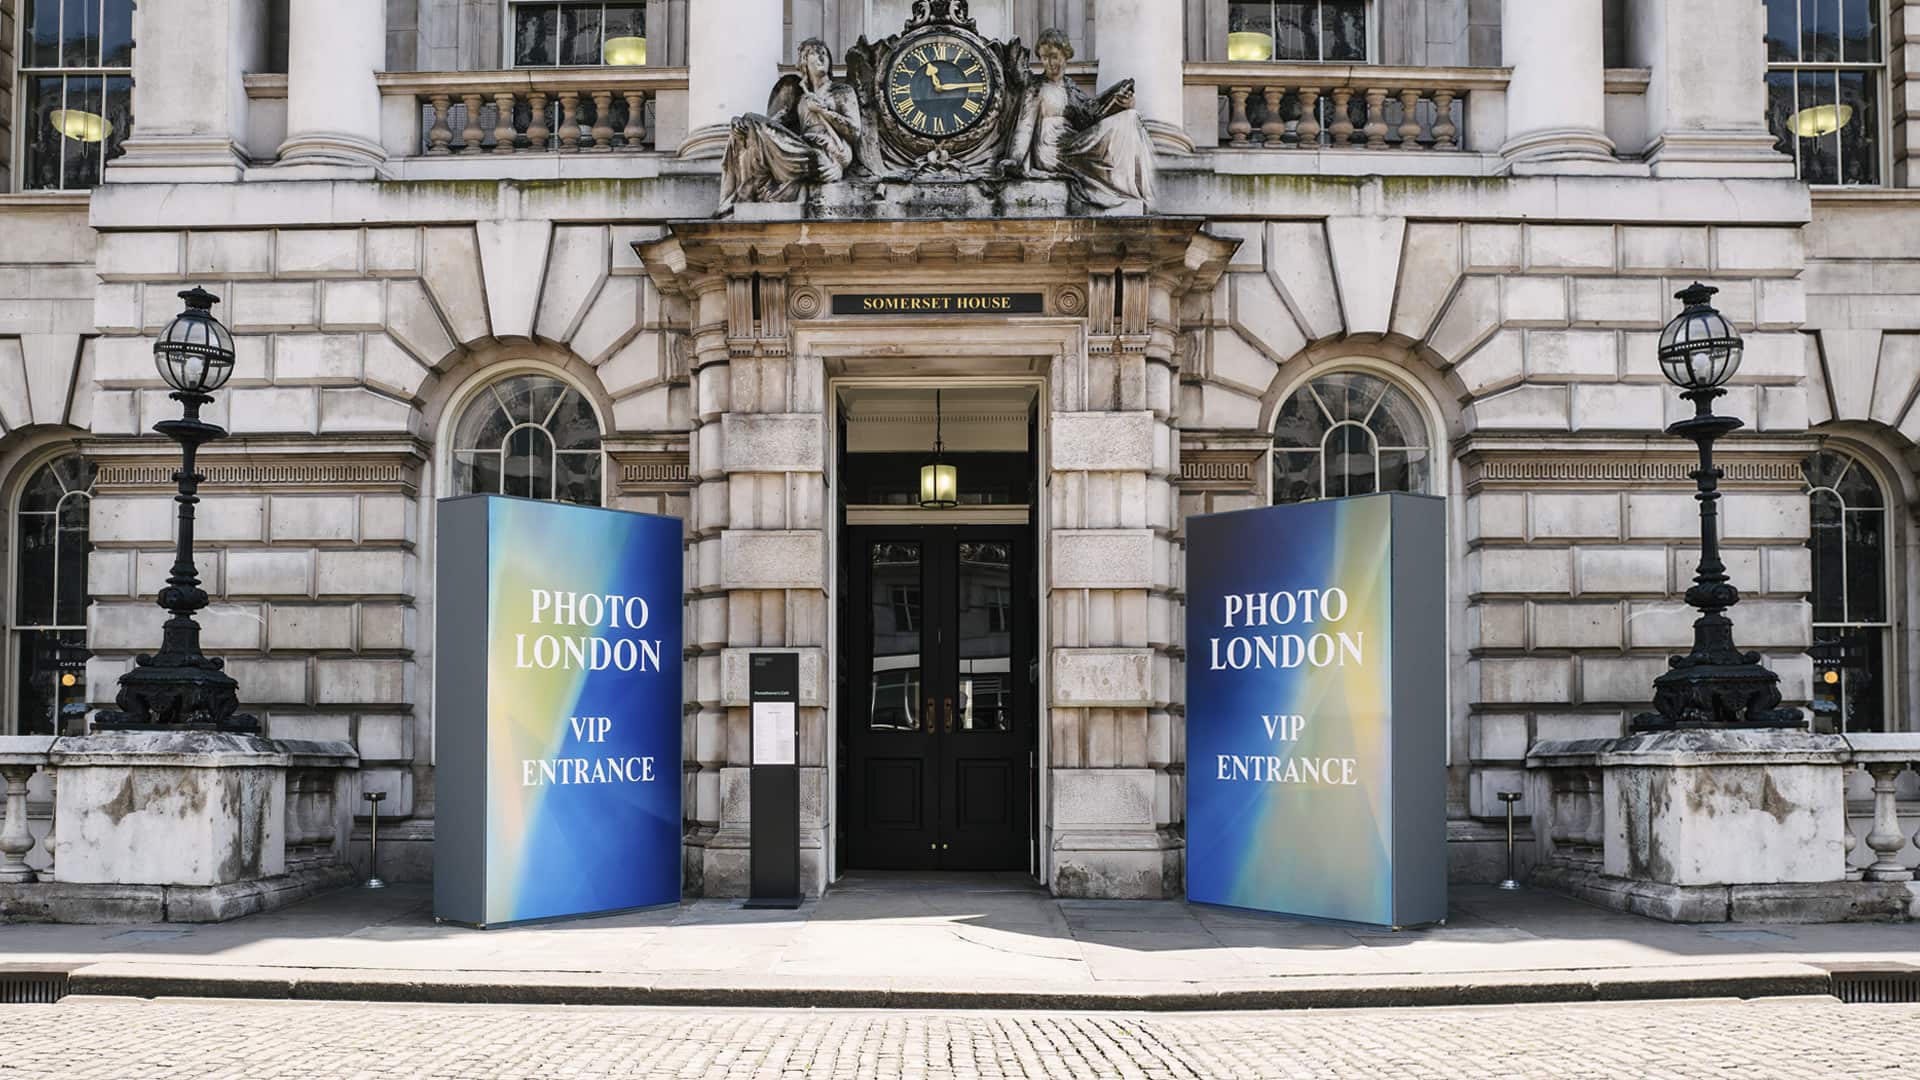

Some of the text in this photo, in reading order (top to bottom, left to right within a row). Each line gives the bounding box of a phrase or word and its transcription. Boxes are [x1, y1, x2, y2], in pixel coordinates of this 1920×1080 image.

[863, 296, 1011, 310] SOMERSET HOUSE
[531, 588, 649, 630] PHOTO
[1223, 587, 1349, 628] PHOTO
[514, 633, 662, 673] LONDON
[1209, 631, 1364, 670] LONDON
[569, 716, 612, 743] VIP
[1261, 714, 1306, 742] VIP
[521, 756, 656, 787] ENTRANCE
[1216, 754, 1358, 785] ENTRANCE
